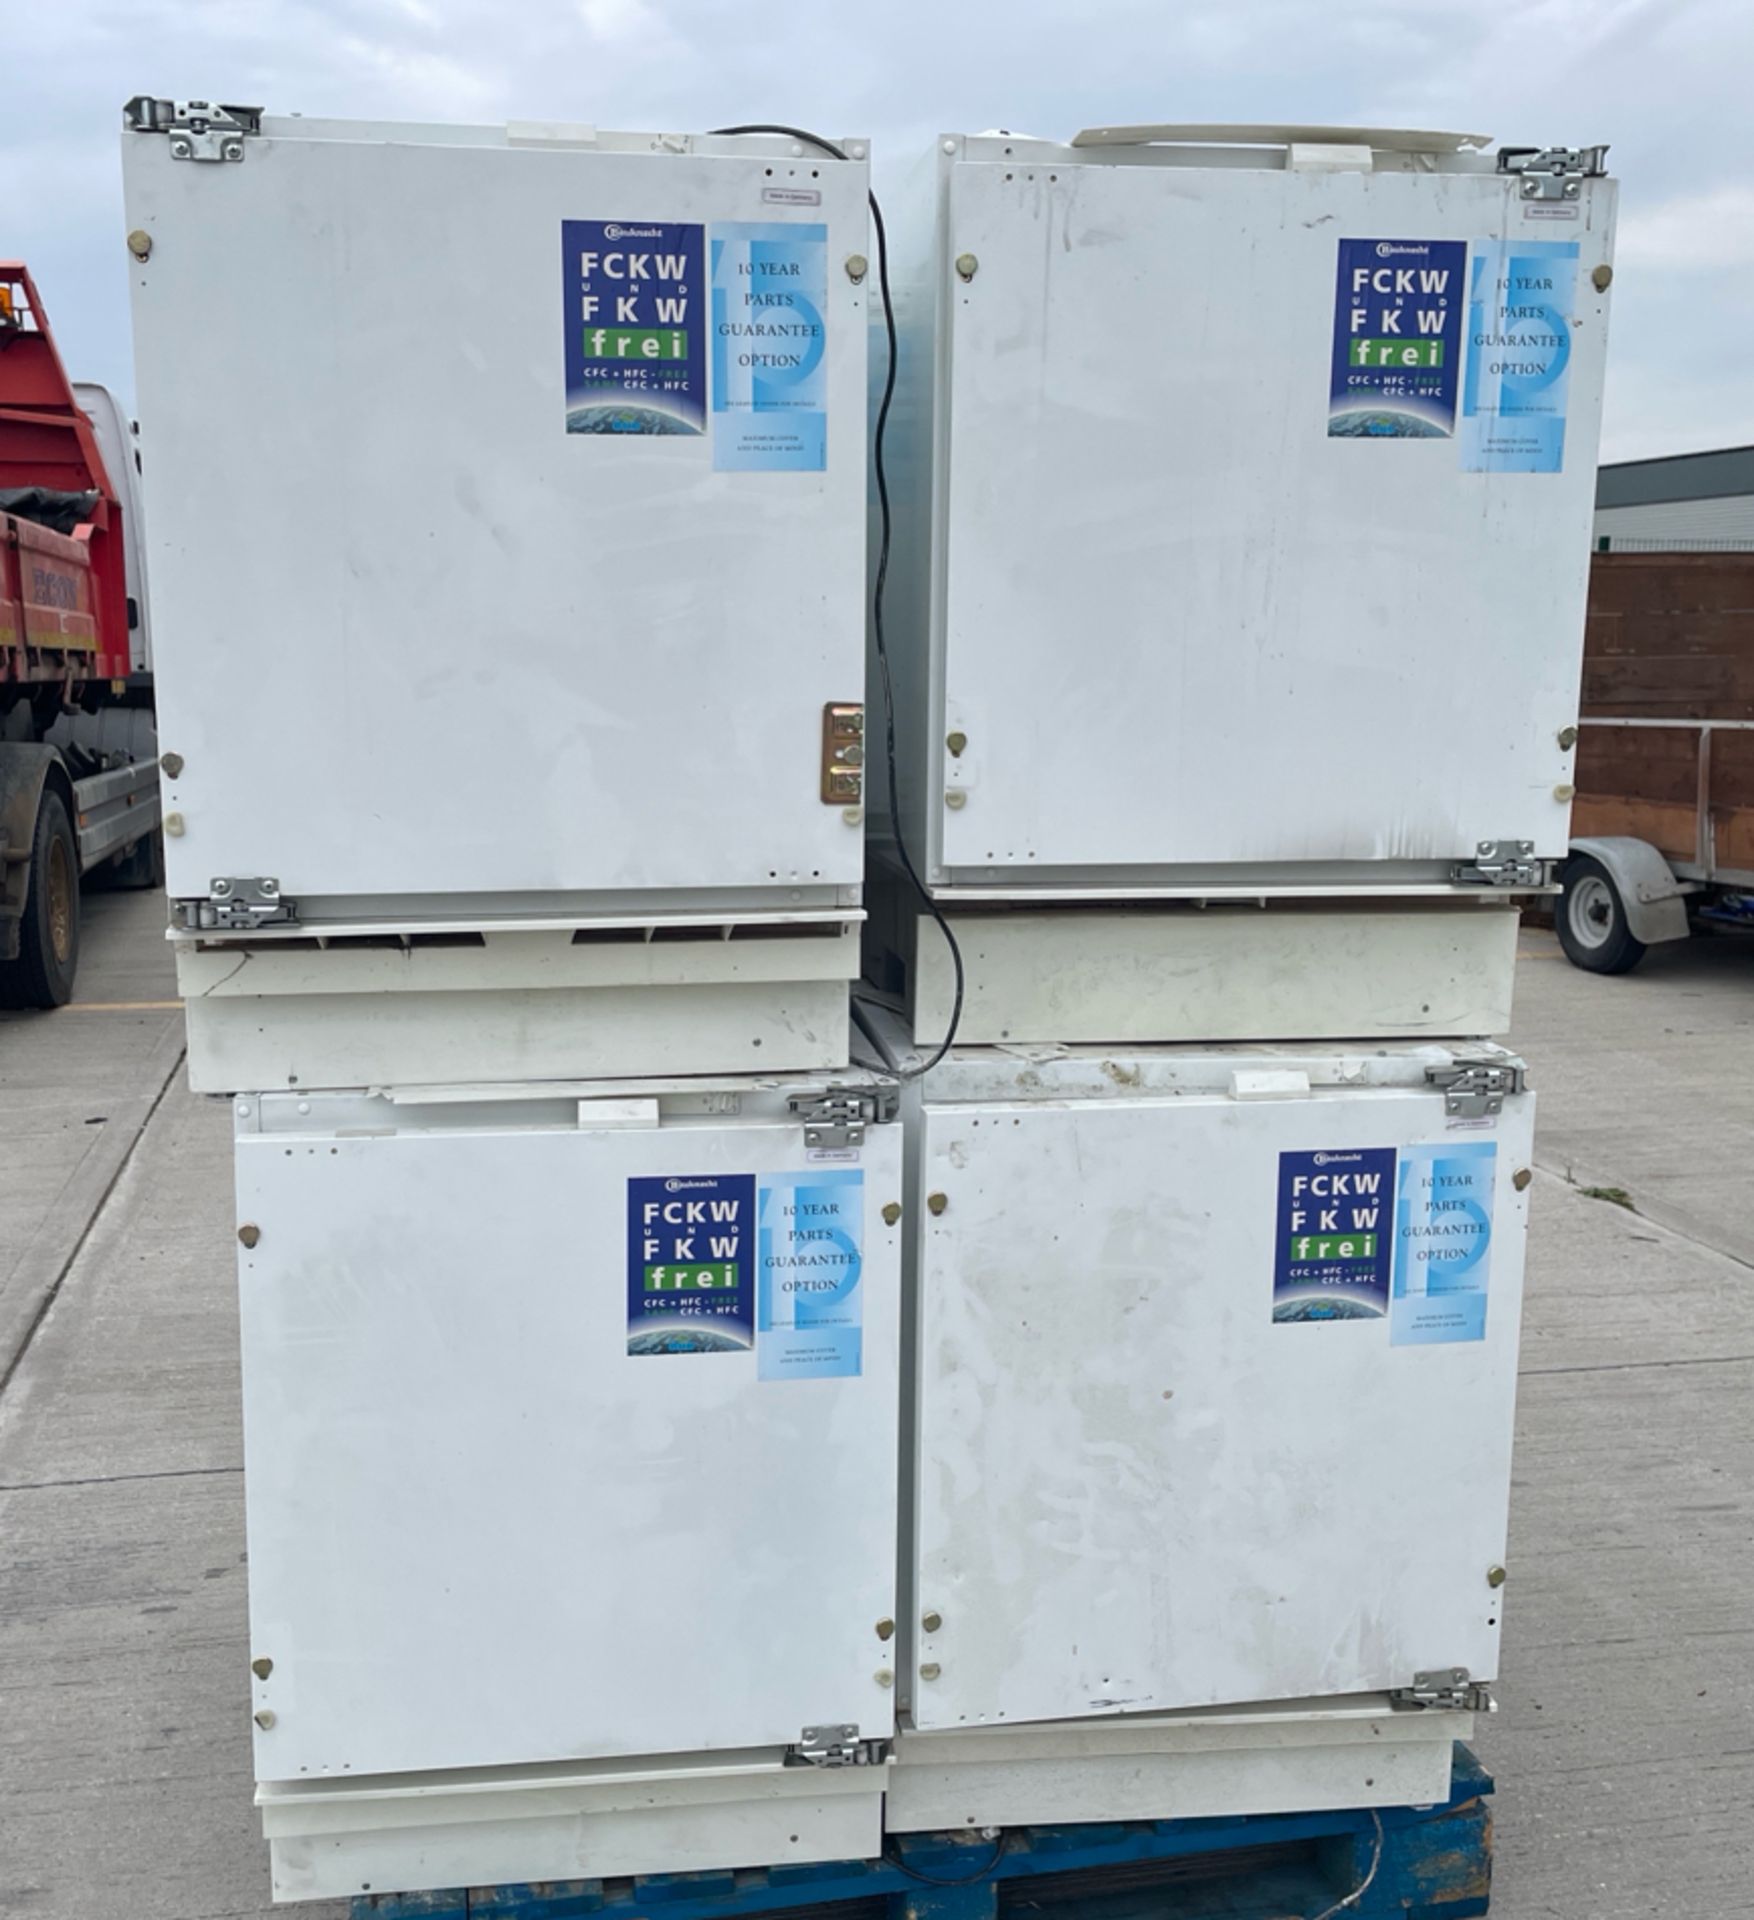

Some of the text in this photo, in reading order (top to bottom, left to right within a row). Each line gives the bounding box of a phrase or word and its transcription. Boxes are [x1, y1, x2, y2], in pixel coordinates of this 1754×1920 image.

[581, 252, 687, 280] FCKW
[738, 263, 800, 276] 10 YEAR
[1353, 268, 1449, 294] FCKW
[1497, 278, 1553, 290] 10 YEAR
[745, 293, 794, 306] PARTS
[1500, 307, 1545, 319] PARTS
[718, 324, 820, 337] GUARANTEE
[591, 329, 681, 358] frei
[1474, 335, 1566, 347] GUARANTEE
[1357, 340, 1437, 366] frei
[738, 354, 801, 367] OPTION
[584, 367, 608, 377] CFC
[1490, 363, 1546, 375] OPTION
[623, 380, 647, 389] CFC
[1347, 376, 1370, 385] CFC
[1382, 387, 1405, 396] CFC
[1293, 1174, 1380, 1197] FCKW
[1422, 1175, 1473, 1188] 10 YEAR
[644, 1200, 739, 1224] FCKW
[783, 1204, 839, 1216] 10 YEAR
[1425, 1201, 1466, 1212] PARTS
[789, 1230, 833, 1241] PARTS
[1402, 1223, 1486, 1237] GUARANTEE
[1297, 1235, 1371, 1259] frei
[765, 1253, 856, 1268] GUARANTEE
[1417, 1248, 1469, 1262] OPTION
[652, 1265, 732, 1289] frei
[1290, 1268, 1310, 1277] CFC
[782, 1280, 838, 1293] OPTION
[644, 1299, 666, 1308] CFC
[680, 1307, 701, 1316] CFC
